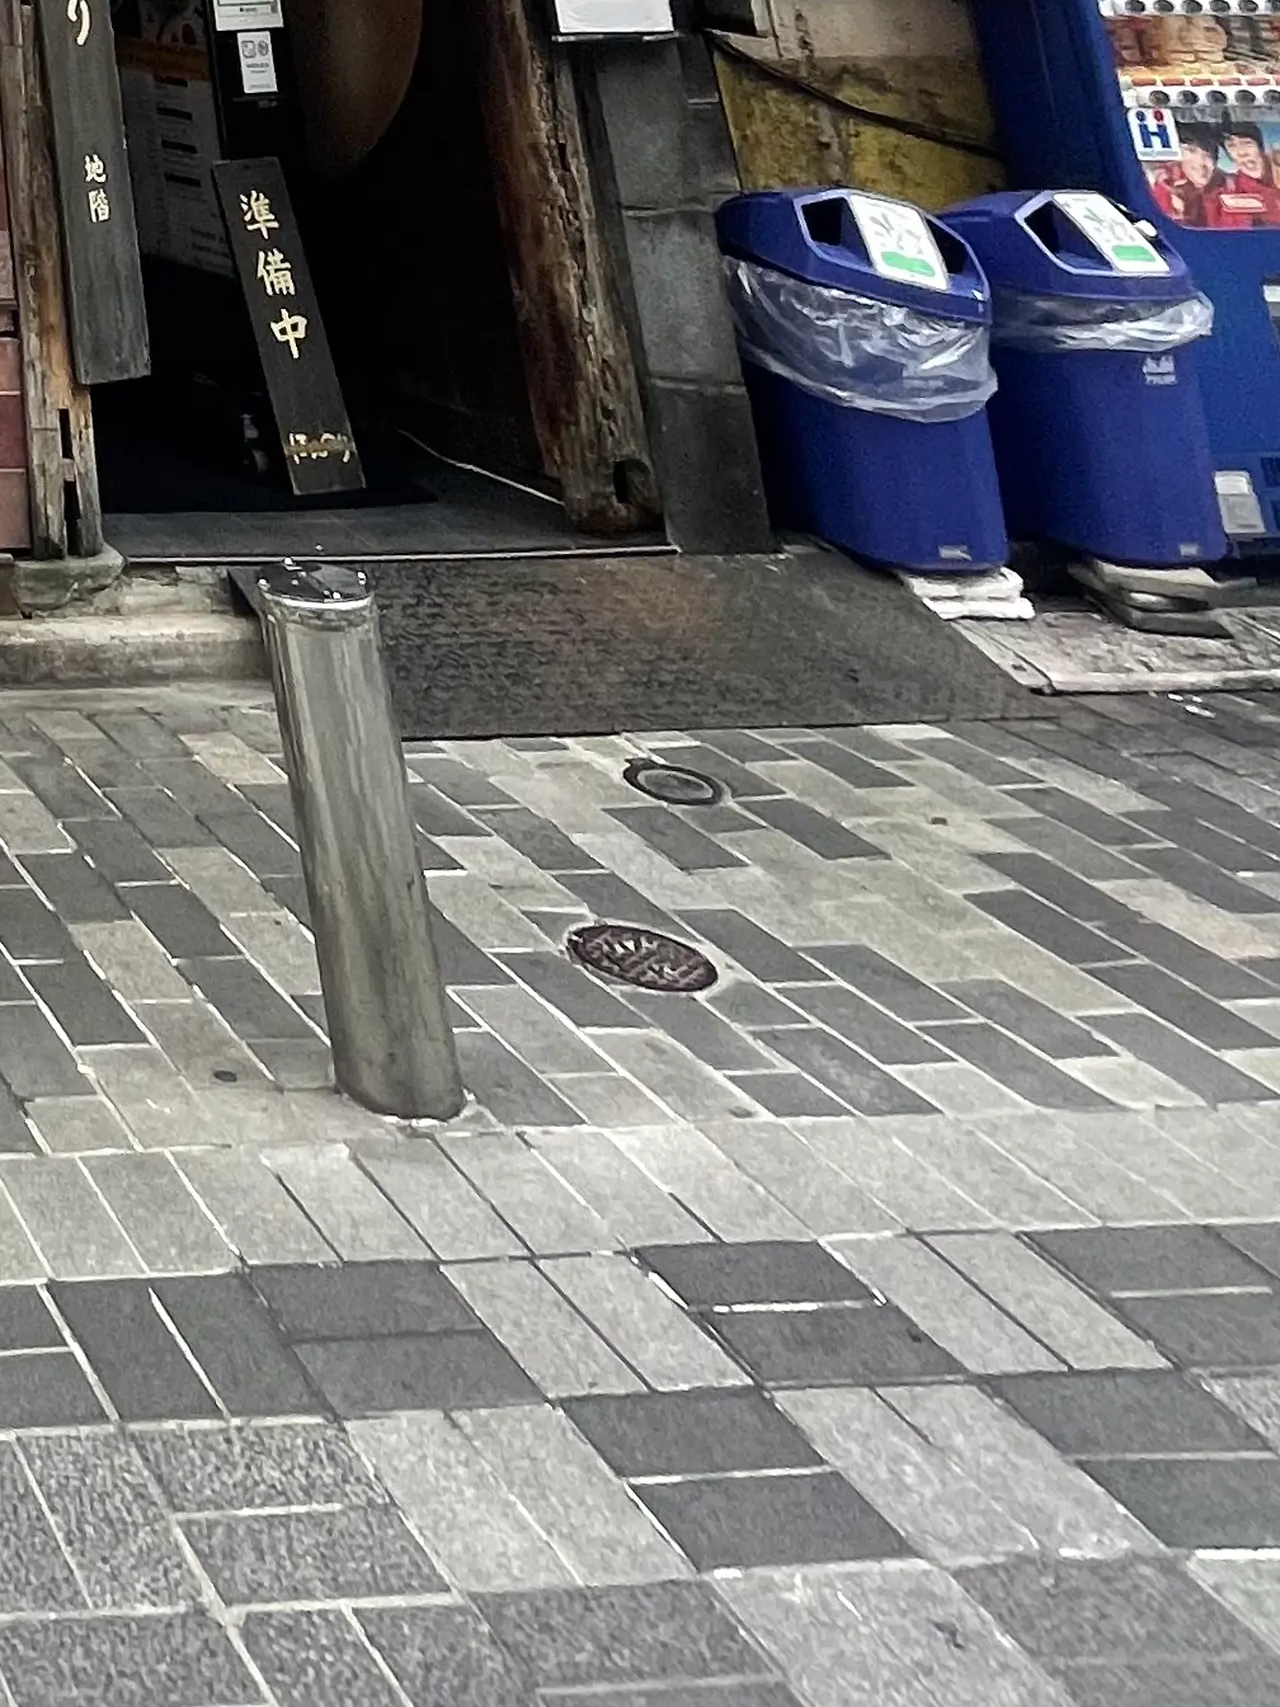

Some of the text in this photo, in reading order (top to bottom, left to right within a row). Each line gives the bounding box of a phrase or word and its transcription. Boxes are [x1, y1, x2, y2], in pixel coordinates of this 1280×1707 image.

[83, 153, 111, 226] 地階
[238, 189, 309, 360] 準備中
